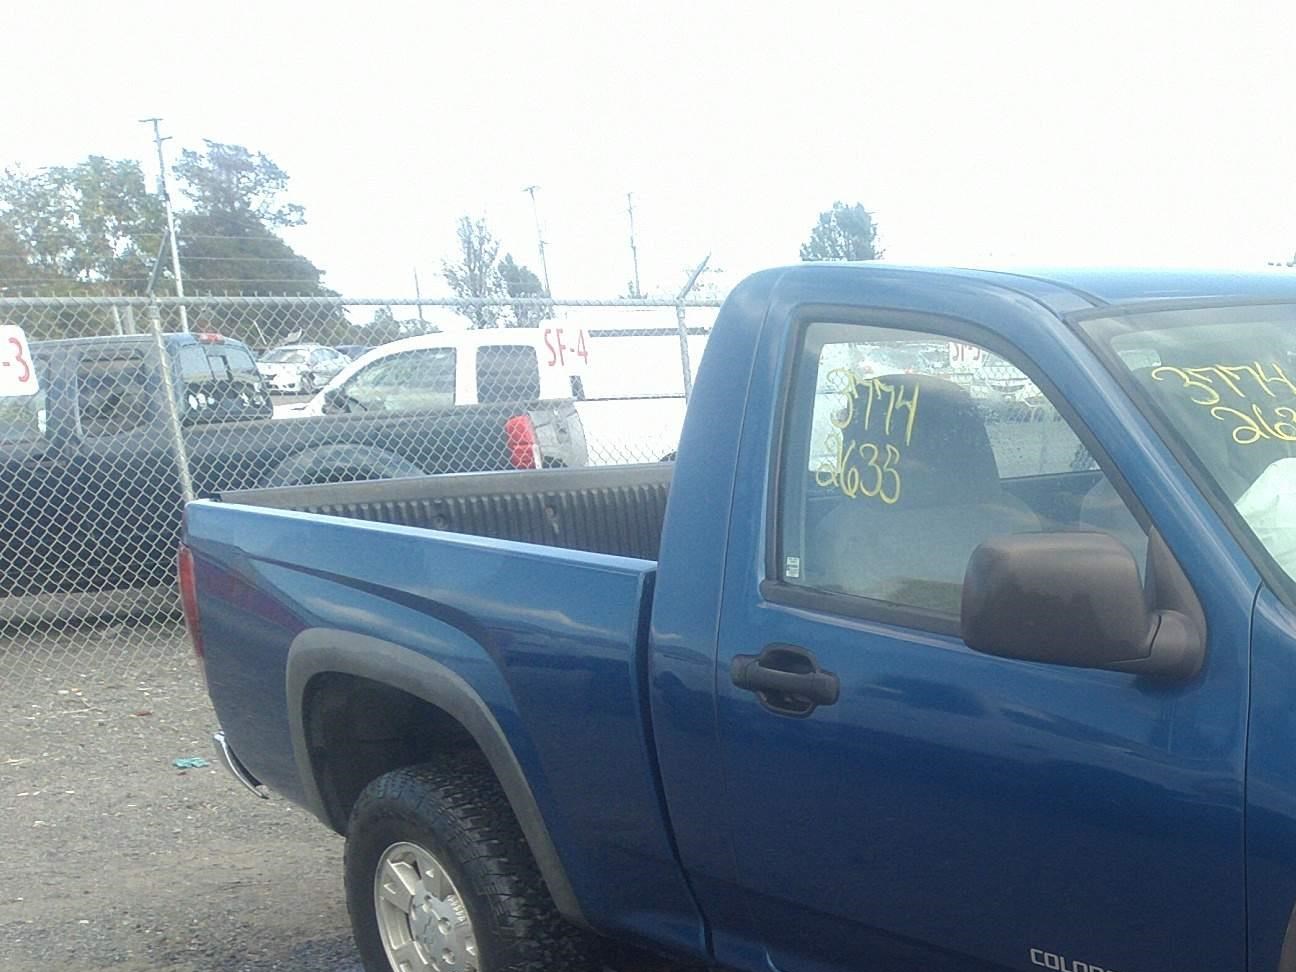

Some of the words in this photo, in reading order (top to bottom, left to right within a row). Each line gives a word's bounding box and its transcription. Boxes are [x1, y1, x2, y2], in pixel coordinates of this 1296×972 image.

[544, 328, 588, 366] SF-4
[826, 368, 920, 447] 3774
[815, 431, 901, 504] 2635
